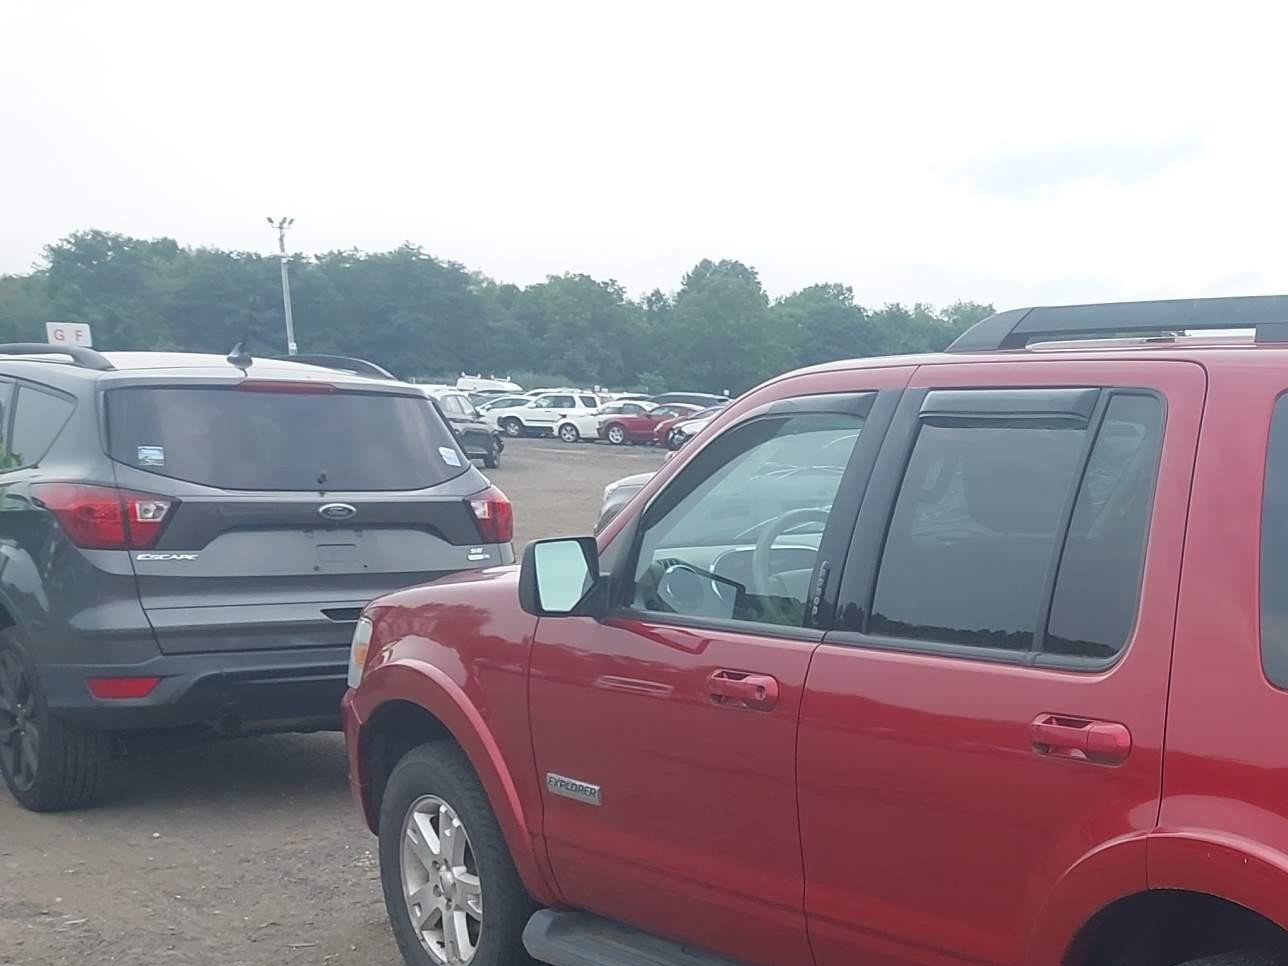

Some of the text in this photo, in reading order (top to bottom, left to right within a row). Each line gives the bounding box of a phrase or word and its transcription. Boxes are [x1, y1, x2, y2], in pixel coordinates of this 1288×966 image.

[54, 328, 84, 342] G F
[548, 776, 597, 798] EXPLORER
